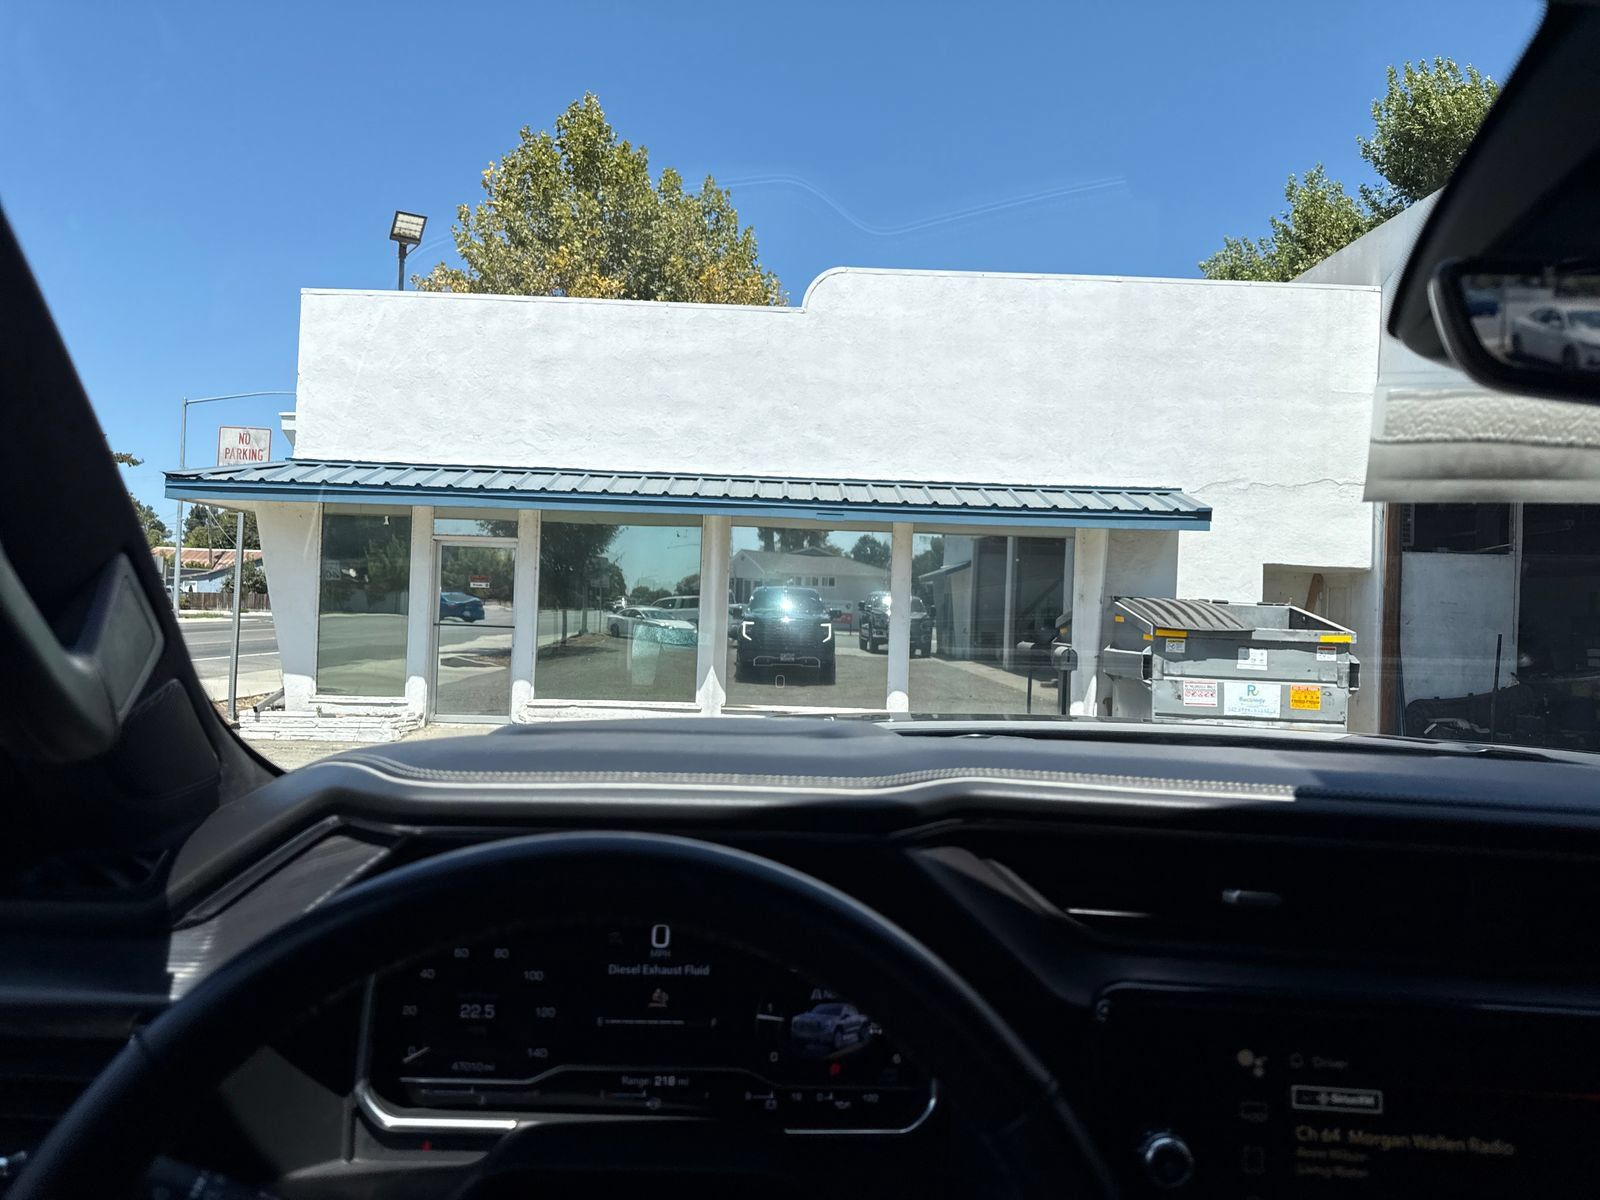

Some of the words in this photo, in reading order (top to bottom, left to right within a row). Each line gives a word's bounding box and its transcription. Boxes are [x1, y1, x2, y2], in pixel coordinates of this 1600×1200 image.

[239, 433, 251, 445] NO
[225, 448, 263, 461] PARKING
[651, 924, 670, 948] 0
[608, 964, 640, 975] Diesel
[642, 965, 682, 976] Exhaust
[685, 965, 710, 976] Fluid
[460, 1003, 496, 1019] 22.5
[1347, 1129, 1410, 1151] Morgan
[1467, 1137, 1516, 1155] Radio
